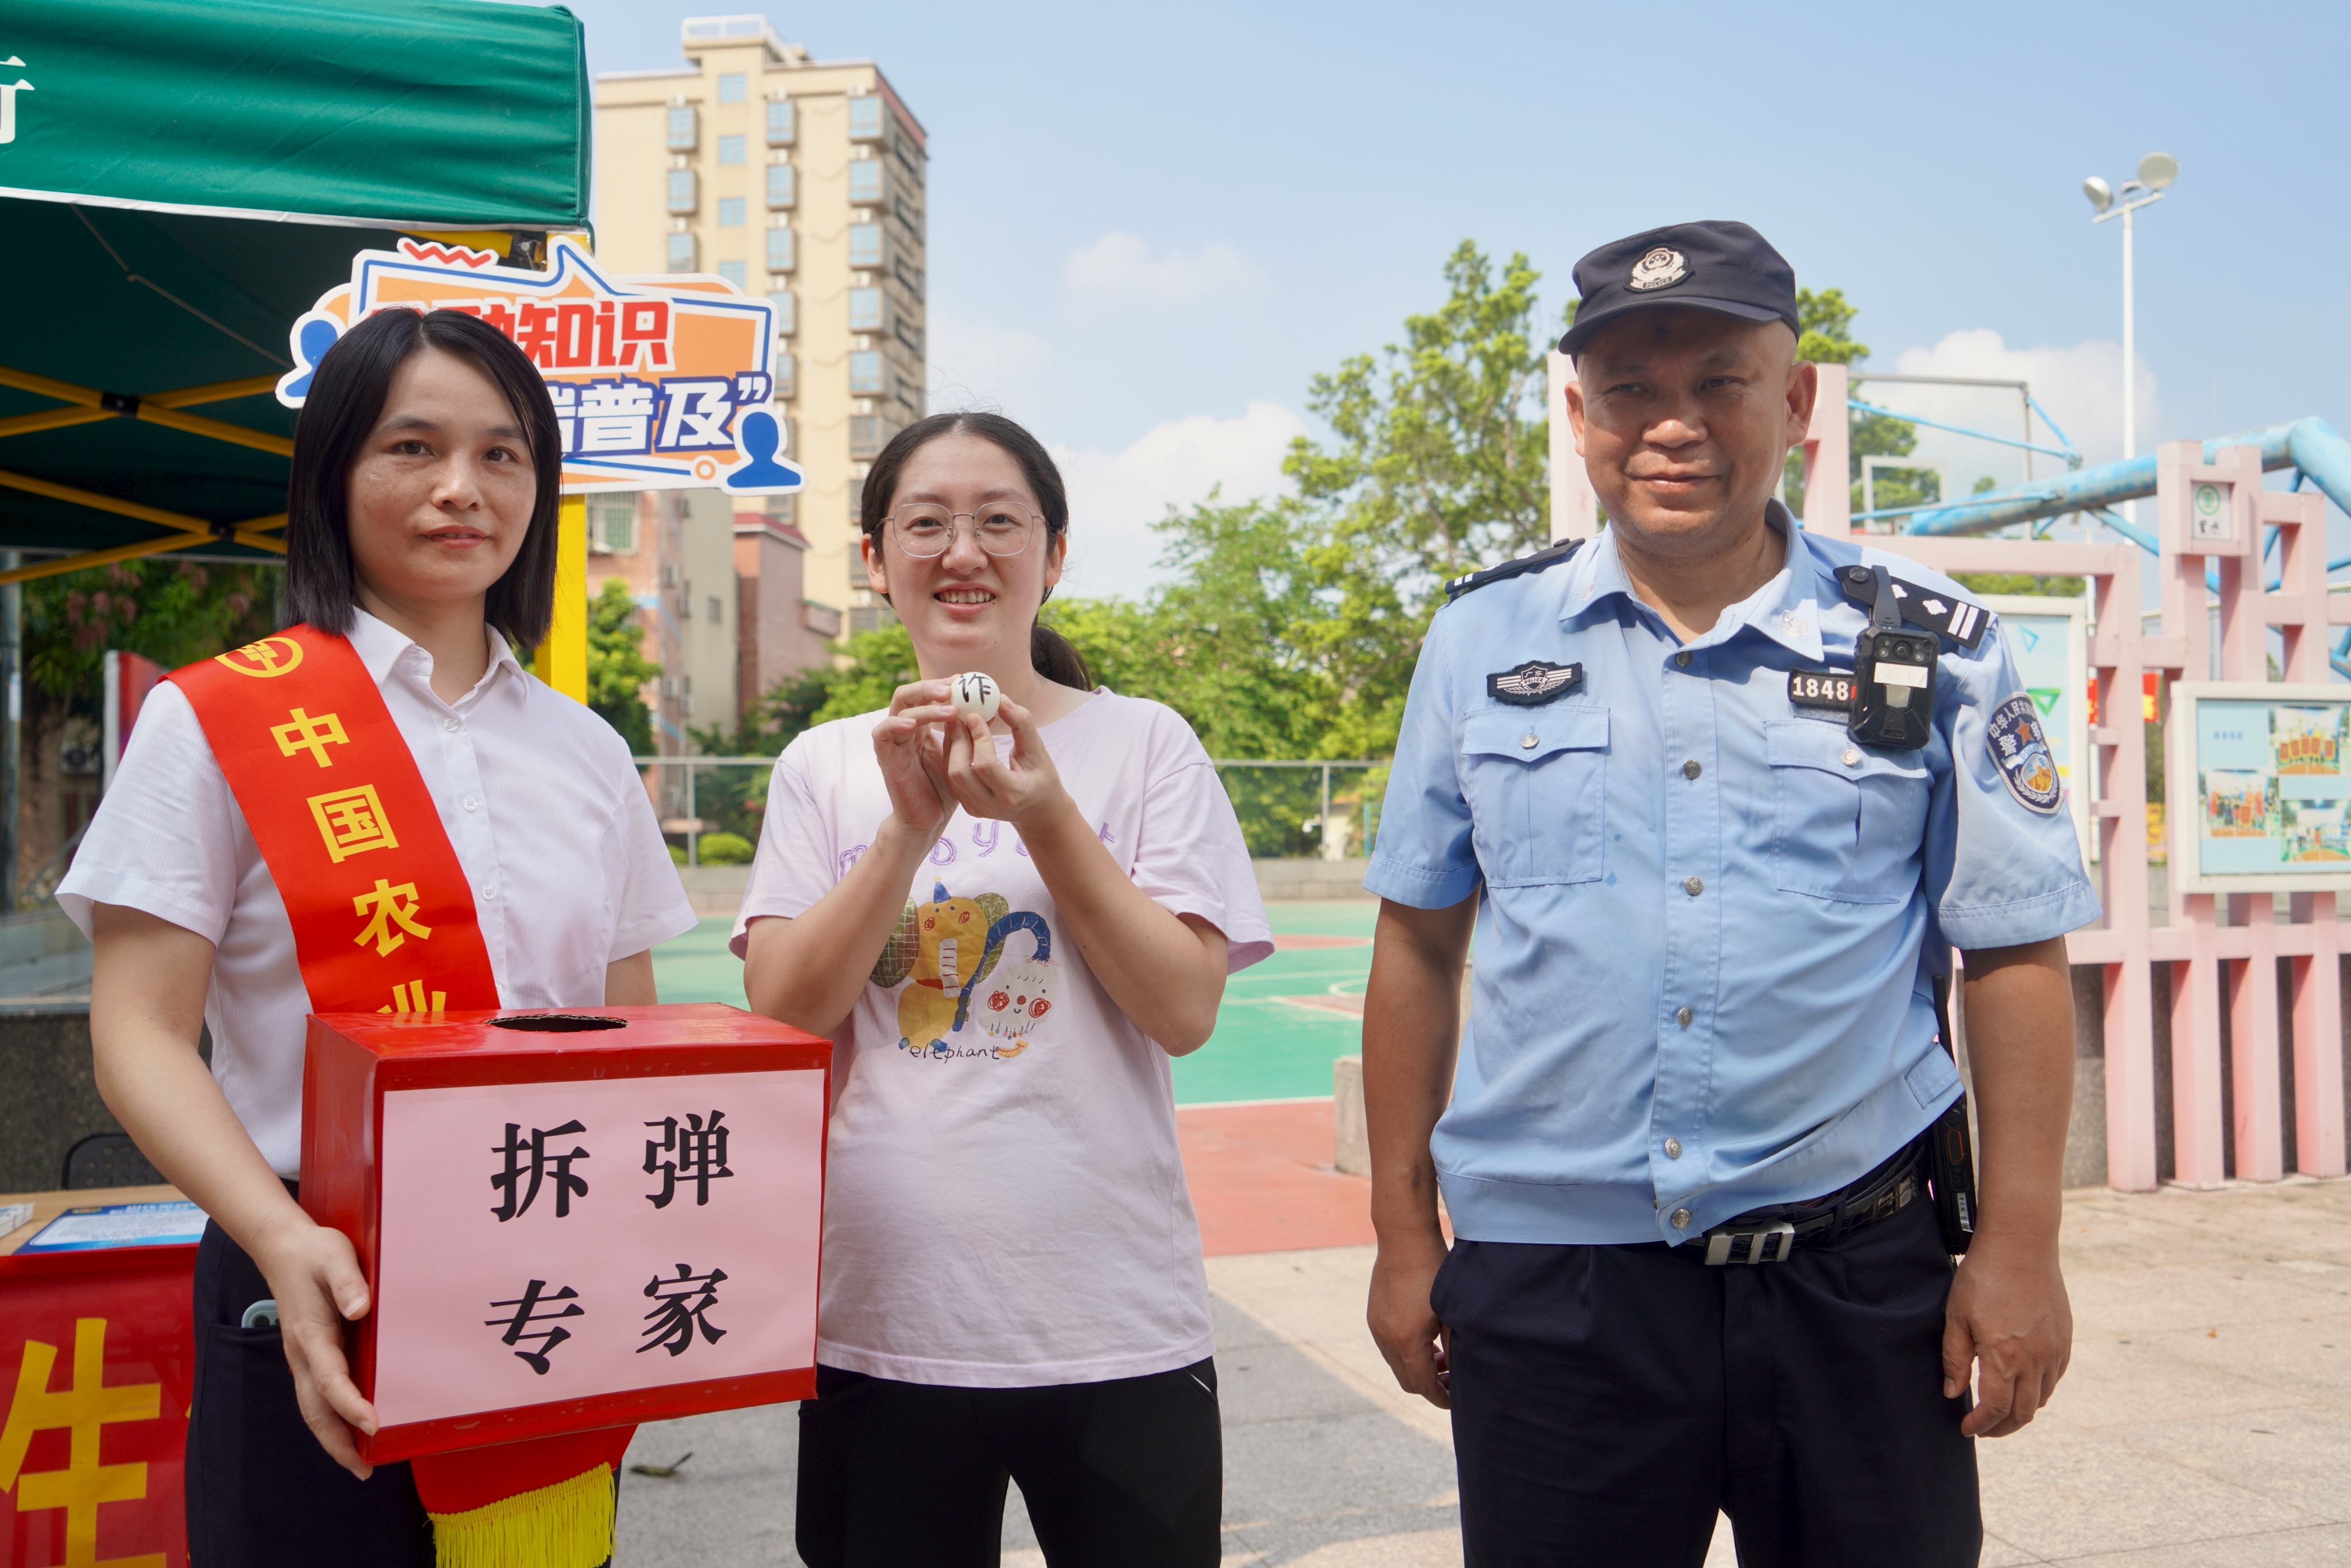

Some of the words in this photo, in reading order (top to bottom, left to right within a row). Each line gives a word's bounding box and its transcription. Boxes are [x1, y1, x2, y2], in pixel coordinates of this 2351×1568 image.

[1646, 277, 1671, 288] POLICE
[1524, 670, 1543, 678] 广东
[958, 673, 991, 705] 诈
[1793, 676, 1844, 701] 1848
[910, 1042, 1000, 1064] elephant
[490, 1109, 735, 1222] 拆弹
[484, 1263, 728, 1376] 专家
